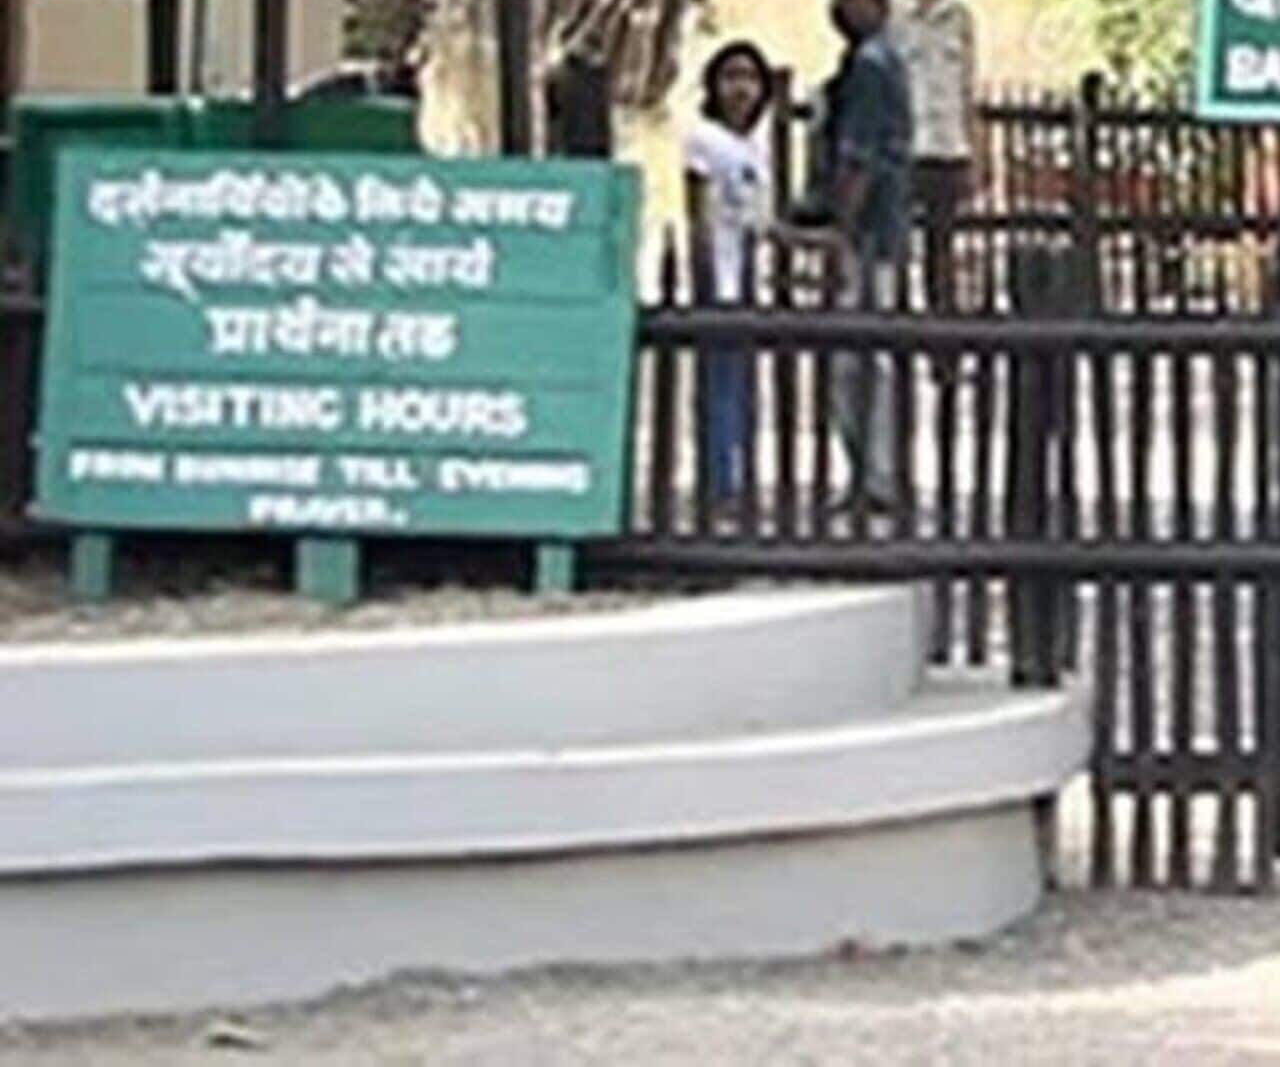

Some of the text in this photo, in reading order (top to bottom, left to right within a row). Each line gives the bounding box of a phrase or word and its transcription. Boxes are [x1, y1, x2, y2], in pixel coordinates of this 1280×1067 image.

[122, 382, 528, 438] VISITING HOURS
[337, 454, 419, 490] TILL
